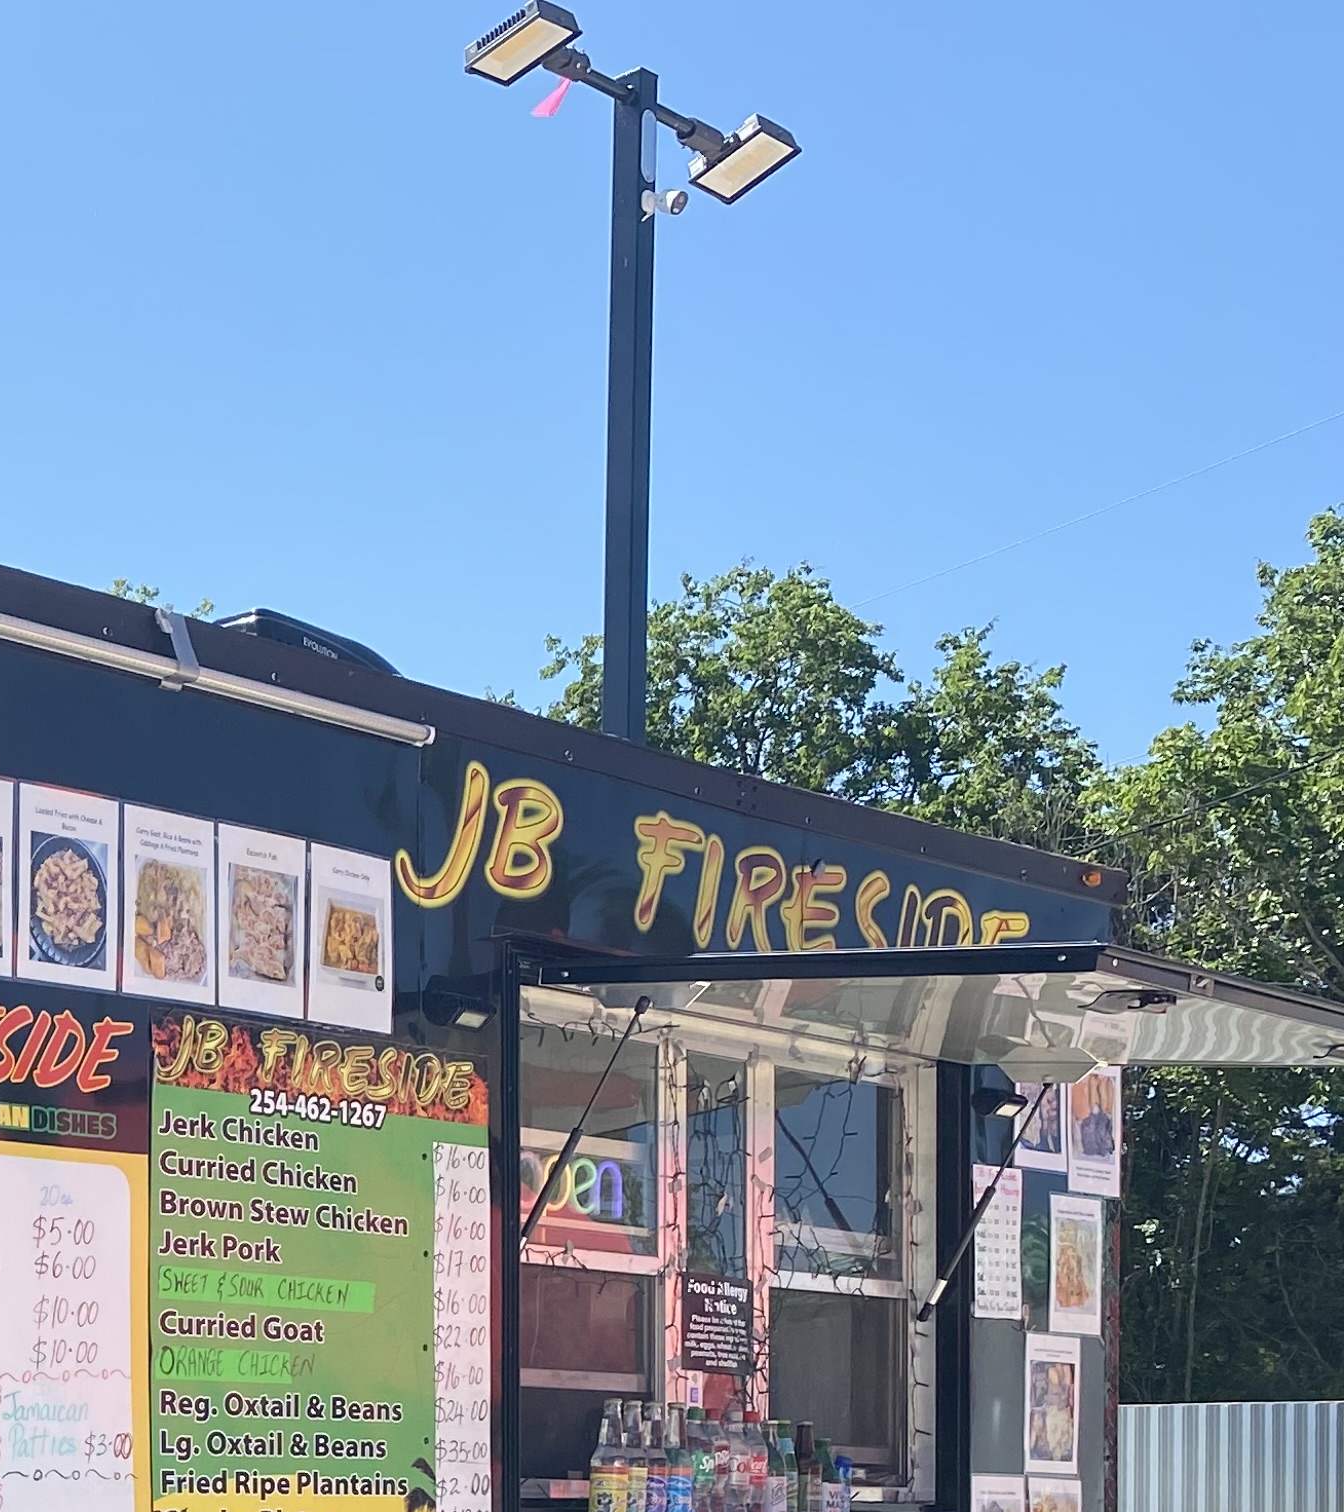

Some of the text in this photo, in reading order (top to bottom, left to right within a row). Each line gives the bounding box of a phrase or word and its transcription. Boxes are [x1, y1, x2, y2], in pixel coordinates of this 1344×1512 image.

[395, 761, 565, 908] JB
[157, 1014, 475, 1109] JB FIRESIDE
[31, 1107, 117, 1139] DISHES
[248, 1088, 387, 1131] 254-462-1267
[158, 1109, 320, 1152] Jerk Chicken
[159, 1150, 358, 1194] Curried Chicken
[159, 1190, 409, 1237] Brown Stew Chicken
[158, 1229, 282, 1264] Jerk Pork
[158, 1310, 325, 1344] Curried Goat
[160, 1390, 404, 1422] Reg. Oxtail & Beans
[160, 1430, 387, 1461] Lg. Oxtail & Beans
[160, 1470, 409, 1500] Fried Ripe Plantains
